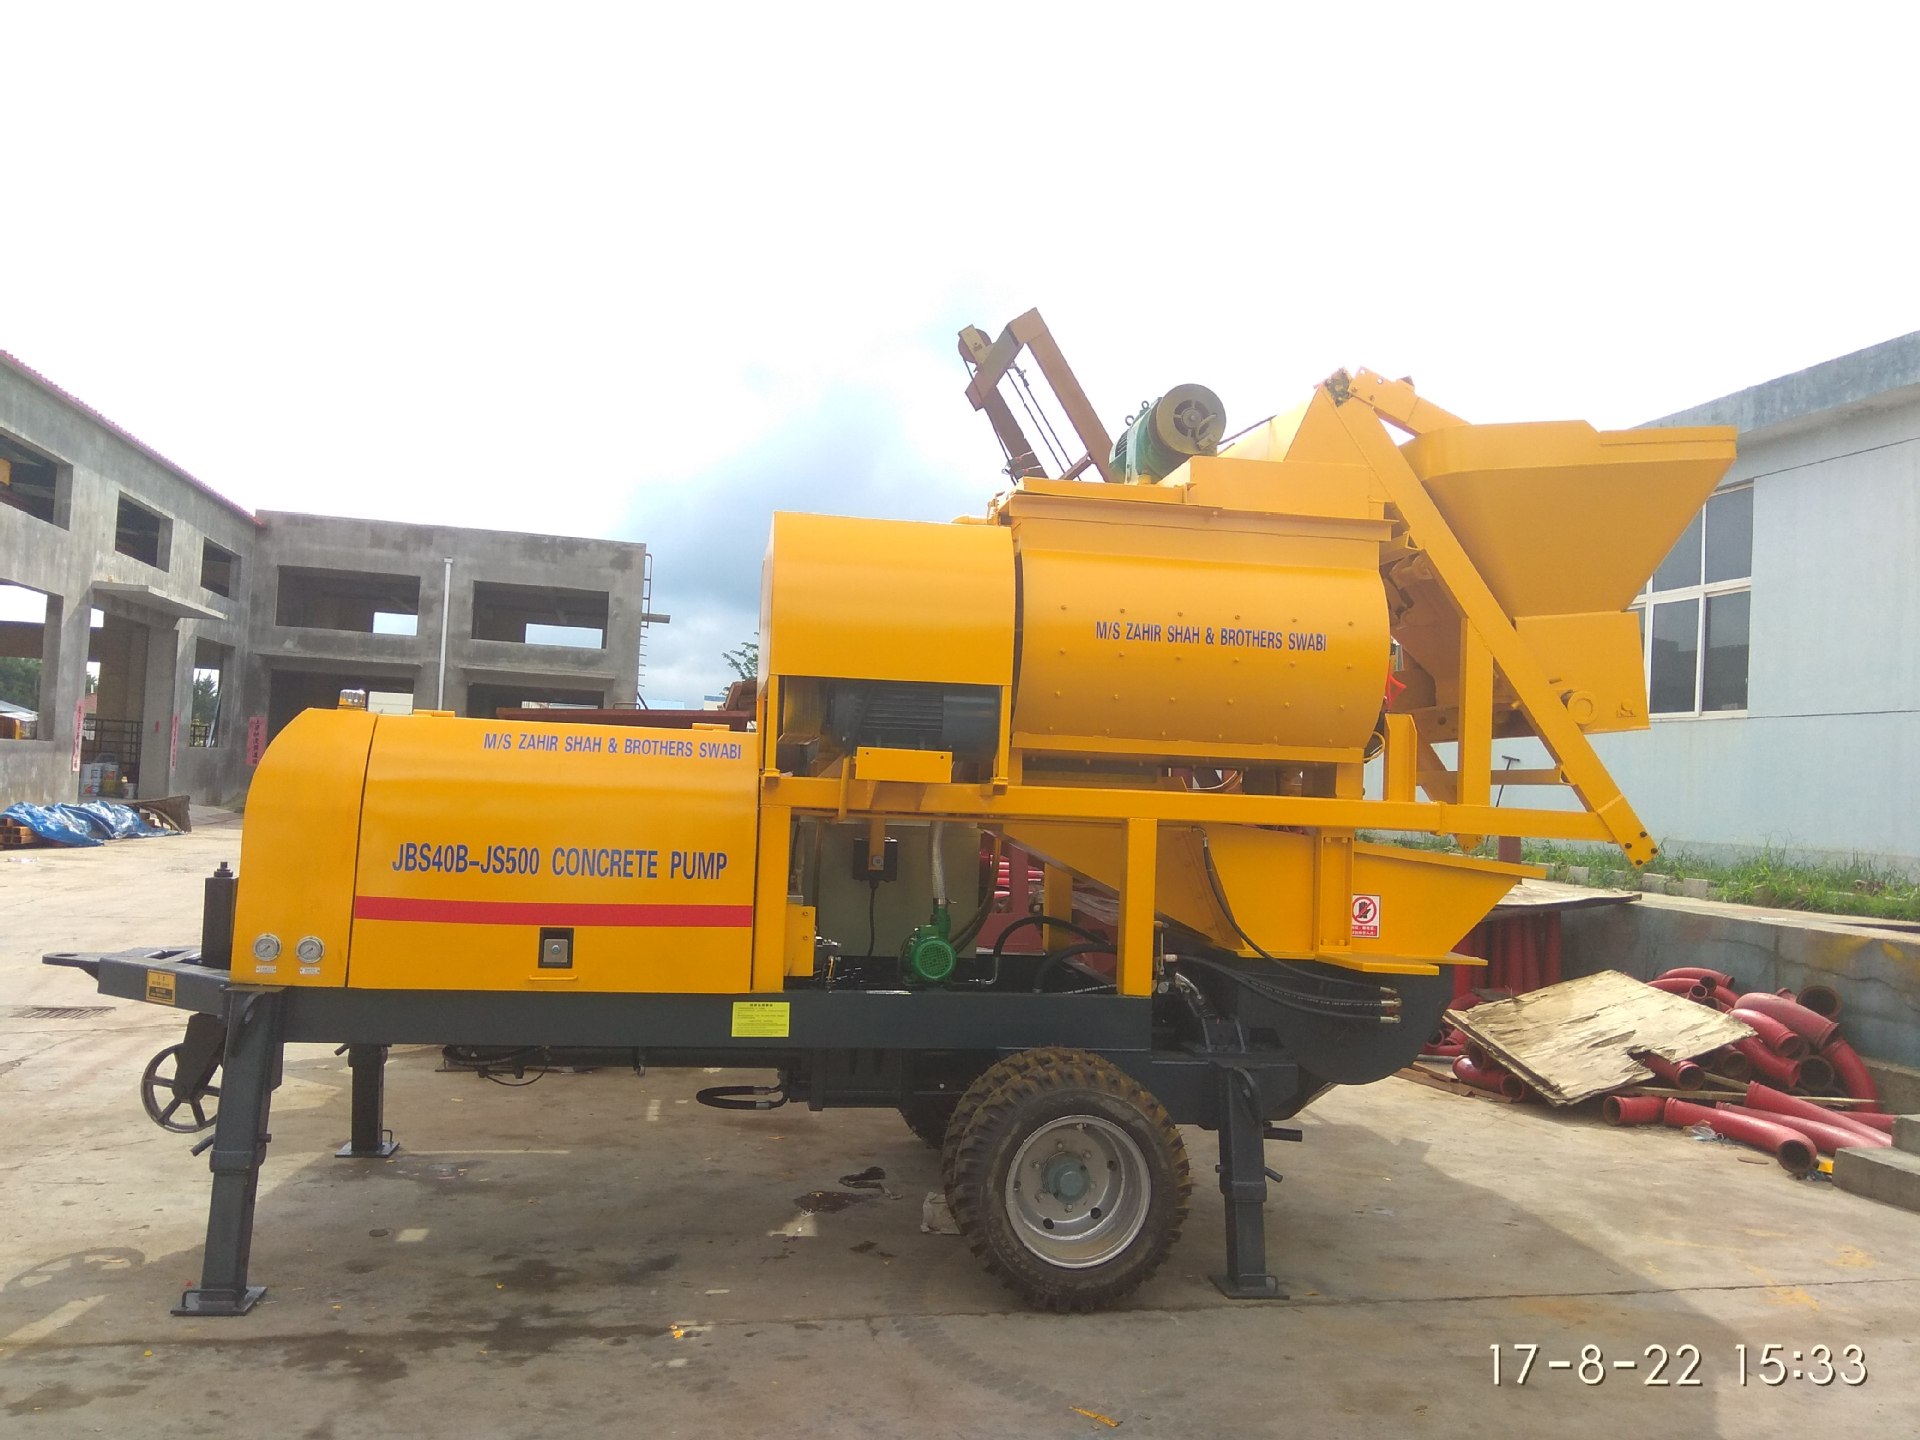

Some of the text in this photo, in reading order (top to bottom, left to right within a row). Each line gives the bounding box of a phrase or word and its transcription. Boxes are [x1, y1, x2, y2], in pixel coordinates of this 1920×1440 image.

[1096, 621, 1327, 652] M/S ZAHIR SHAH & BROTHERS SWABI
[483, 733, 742, 760] M/S ZAHIR SHAH & BROTHERS SWABI
[392, 843, 728, 880] JBS40B-JS500 CONCRETE PUMP
